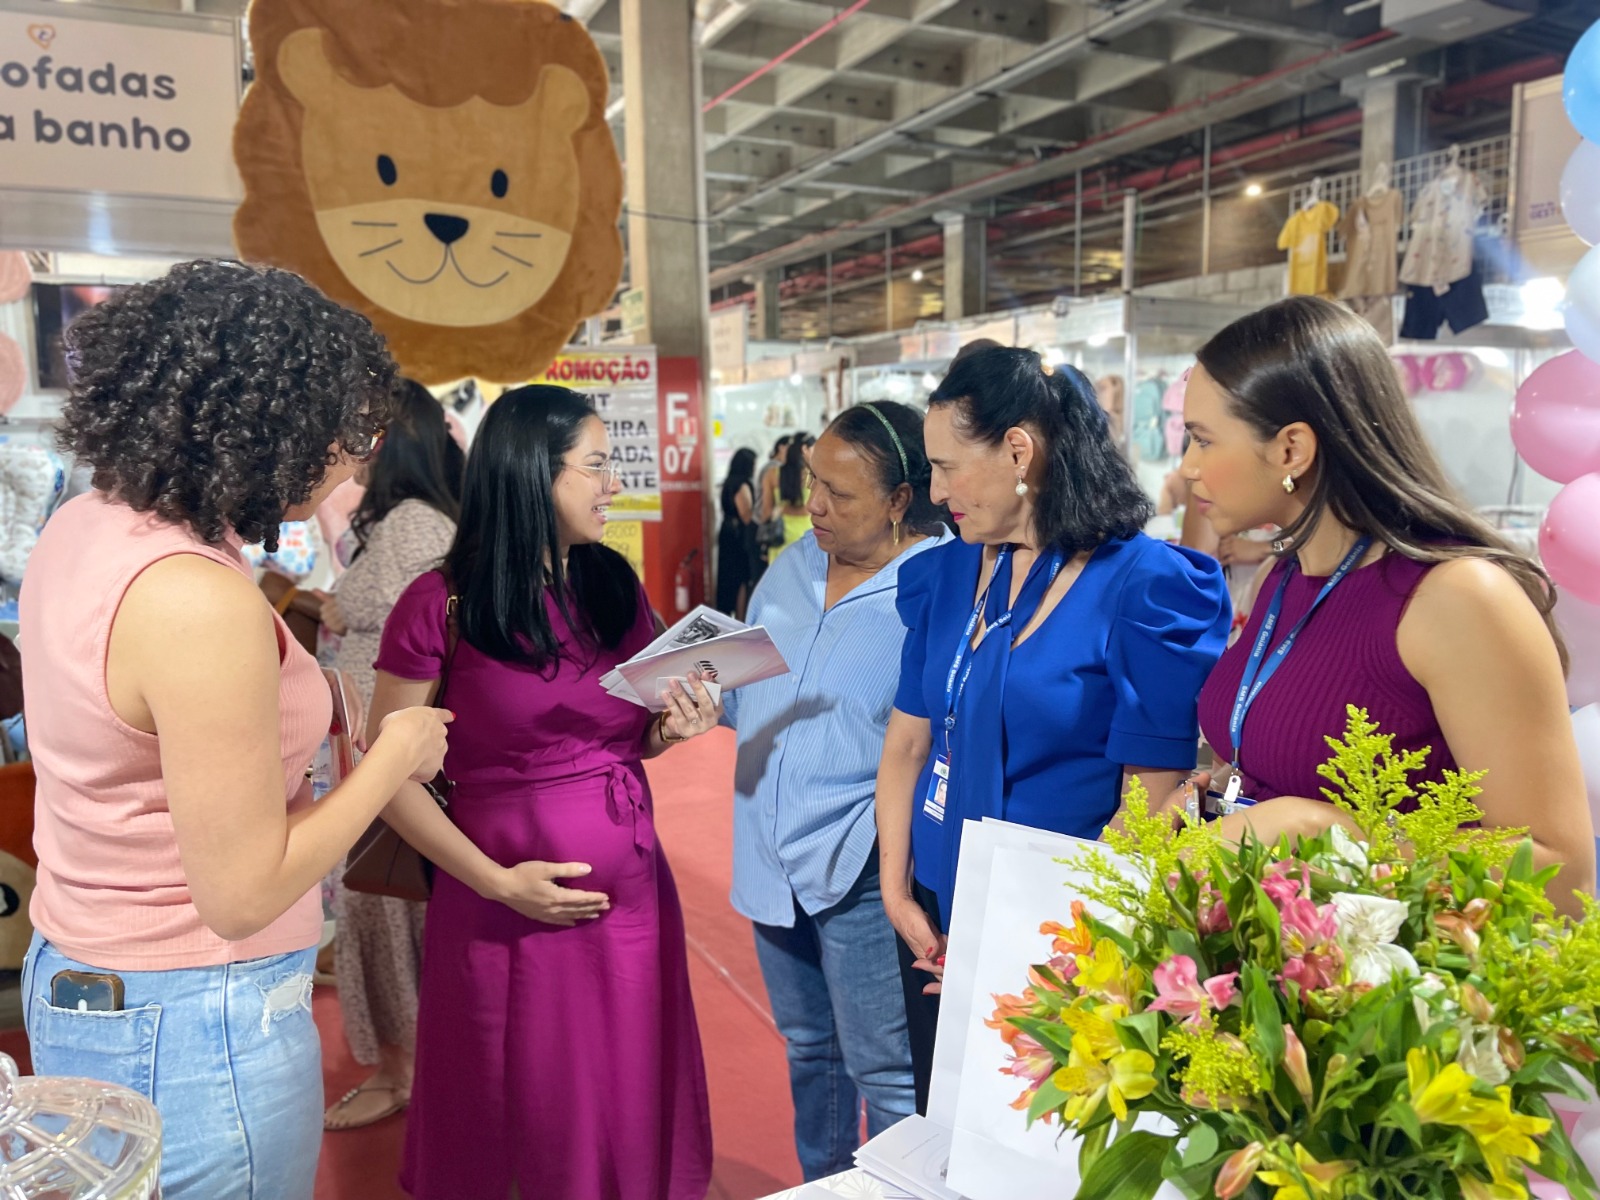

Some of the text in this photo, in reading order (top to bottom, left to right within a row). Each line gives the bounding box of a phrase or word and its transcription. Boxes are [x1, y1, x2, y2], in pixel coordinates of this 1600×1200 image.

[0, 56, 176, 100] ofadas
[34, 110, 191, 152] banho
[546, 354, 650, 384] ROMOÇÃO
[665, 392, 689, 435] F
[663, 445, 694, 475] 07
[1253, 613, 1276, 657] SMS Goiânia
[1238, 685, 1249, 702] SMS
[1231, 703, 1243, 733] Goiânia
